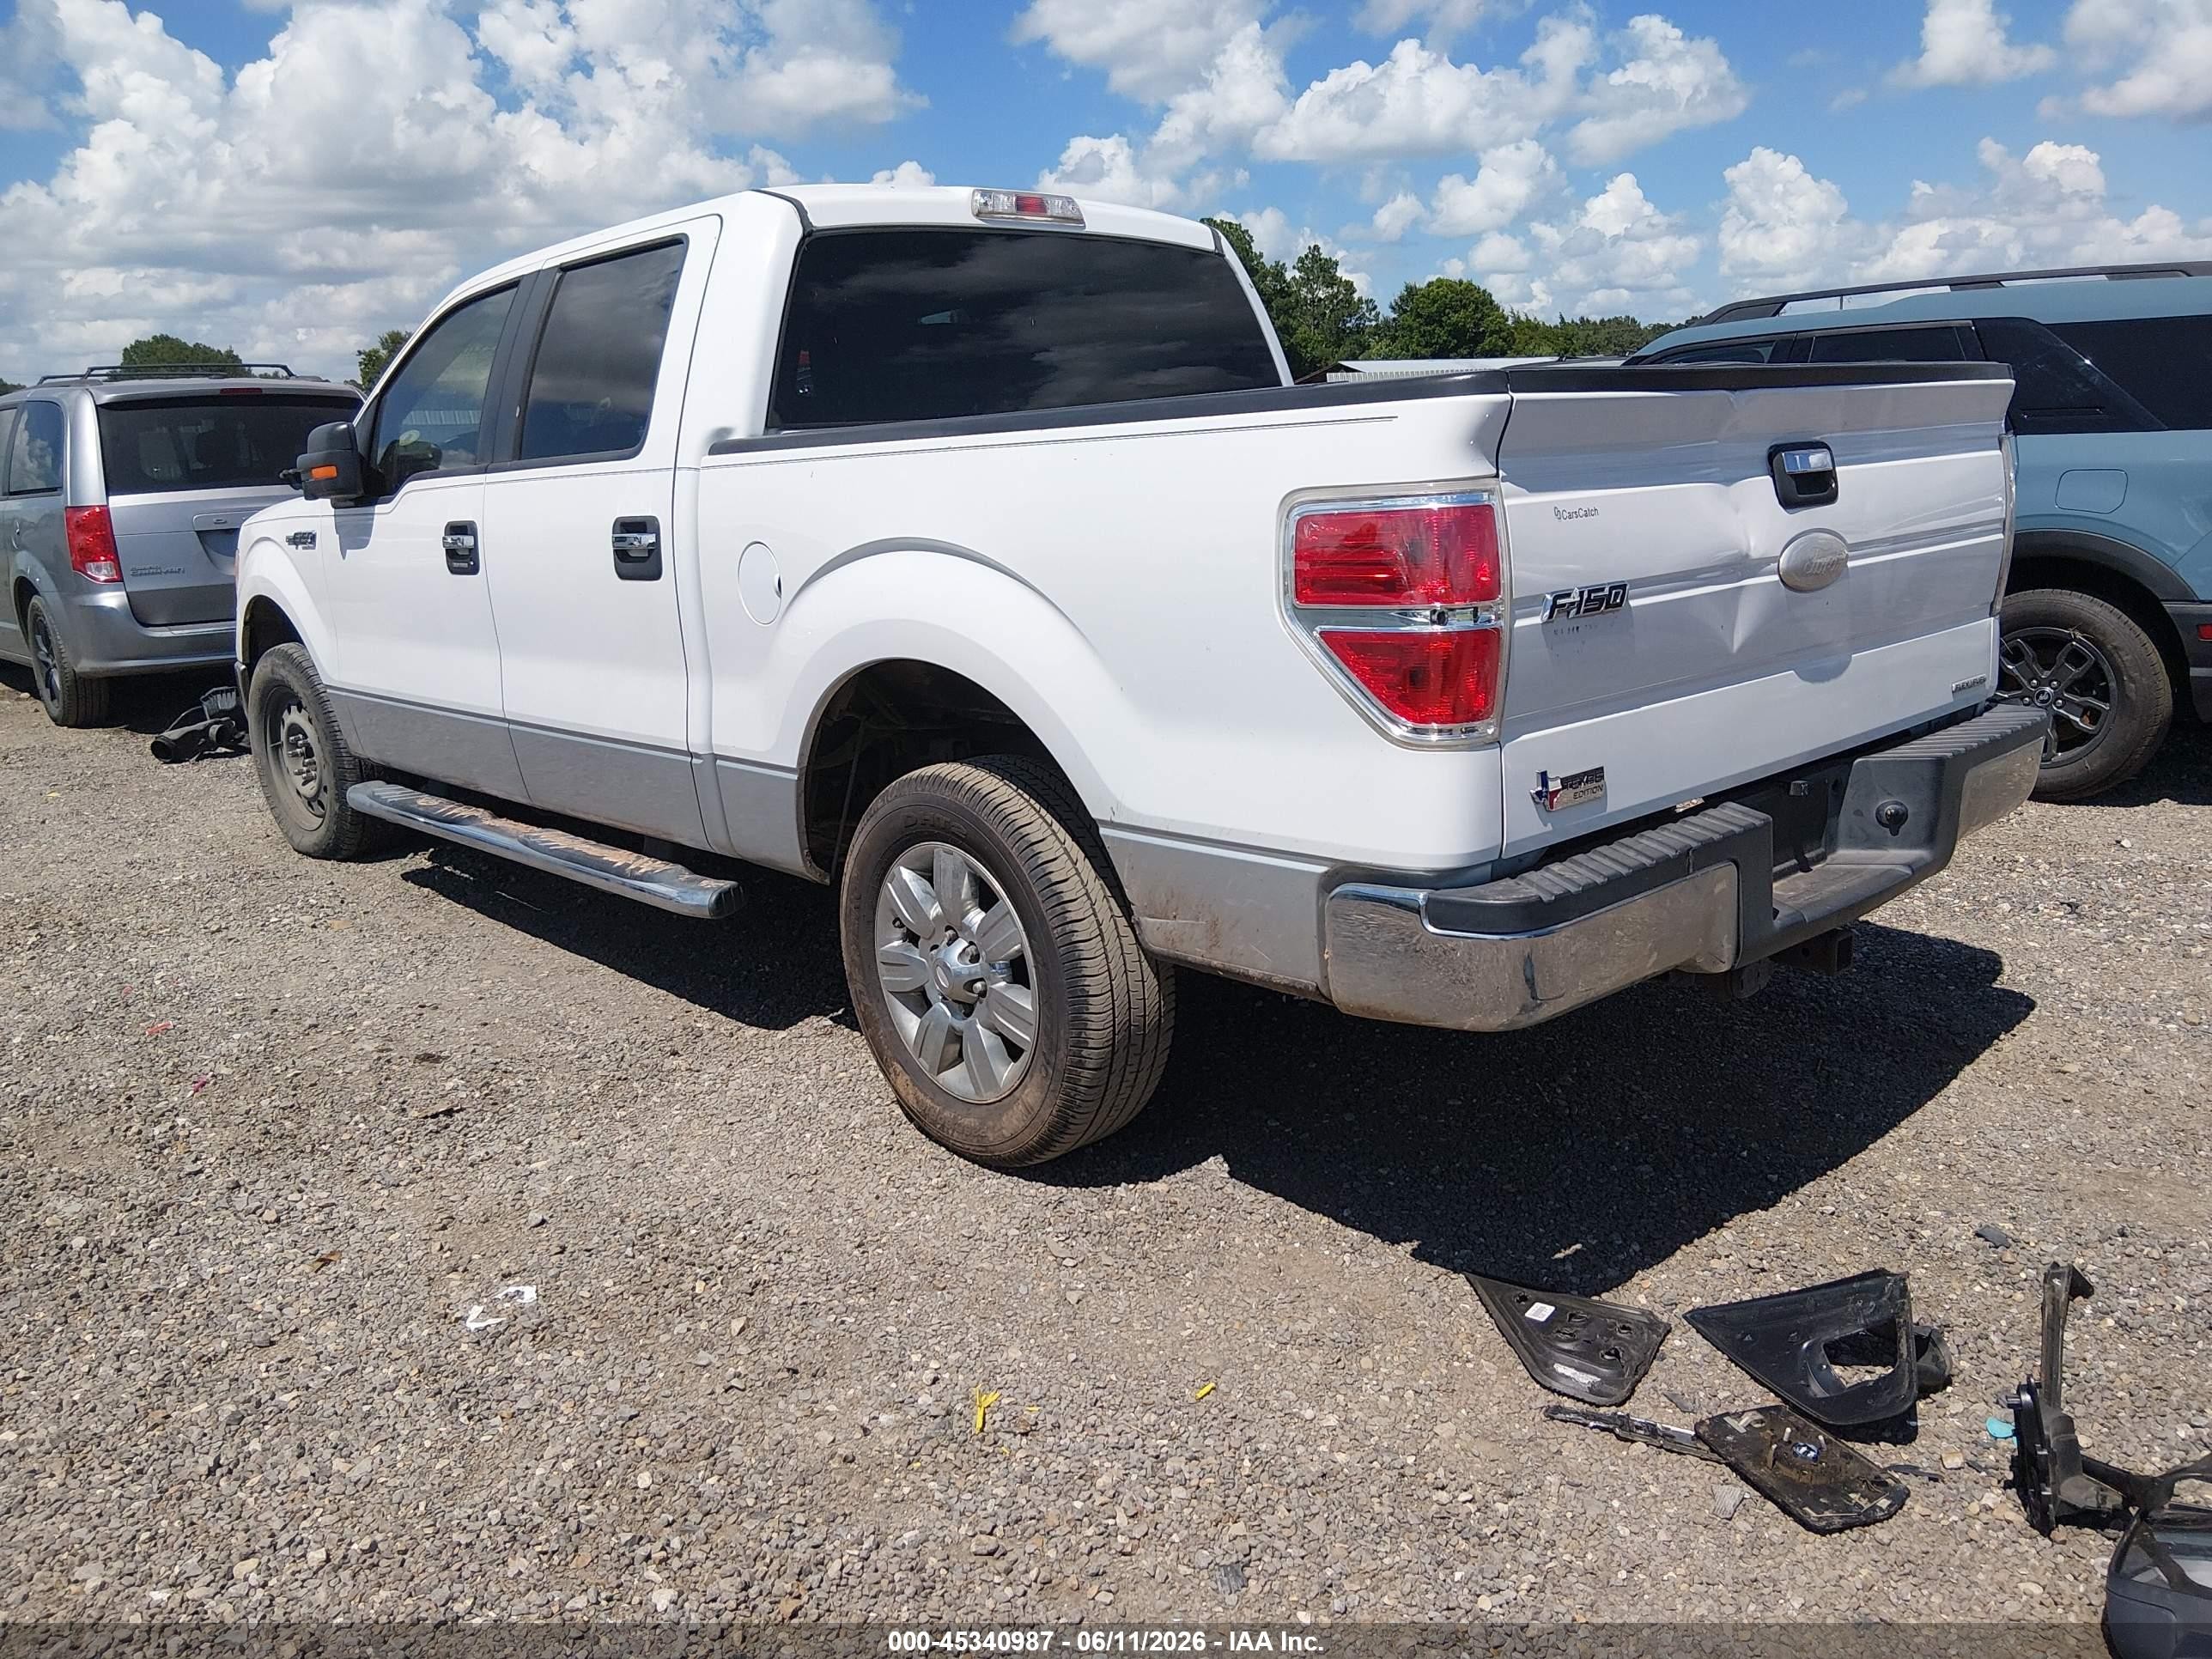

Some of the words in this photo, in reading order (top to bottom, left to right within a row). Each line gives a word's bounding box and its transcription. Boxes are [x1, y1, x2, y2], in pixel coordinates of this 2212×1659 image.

[1561, 507, 1600, 520] CarsCatch
[1542, 582, 1628, 622] F-150
[1572, 785, 1604, 800] EDITION
